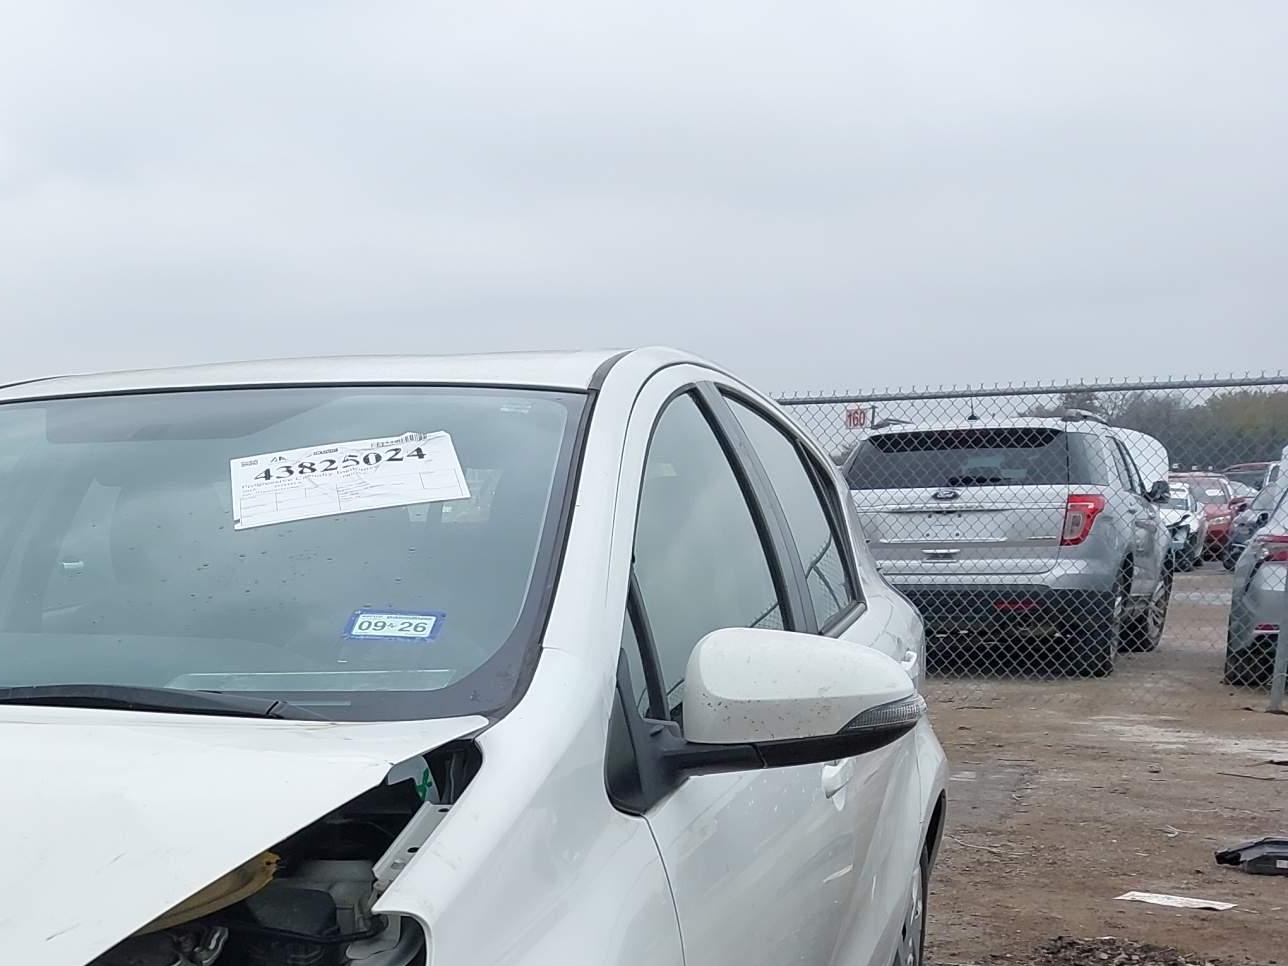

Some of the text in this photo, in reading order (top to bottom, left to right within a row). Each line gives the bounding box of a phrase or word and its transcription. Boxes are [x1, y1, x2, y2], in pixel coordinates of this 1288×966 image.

[847, 409, 866, 427] 160
[253, 446, 427, 481] 43825024
[358, 620, 428, 633] 09 26
